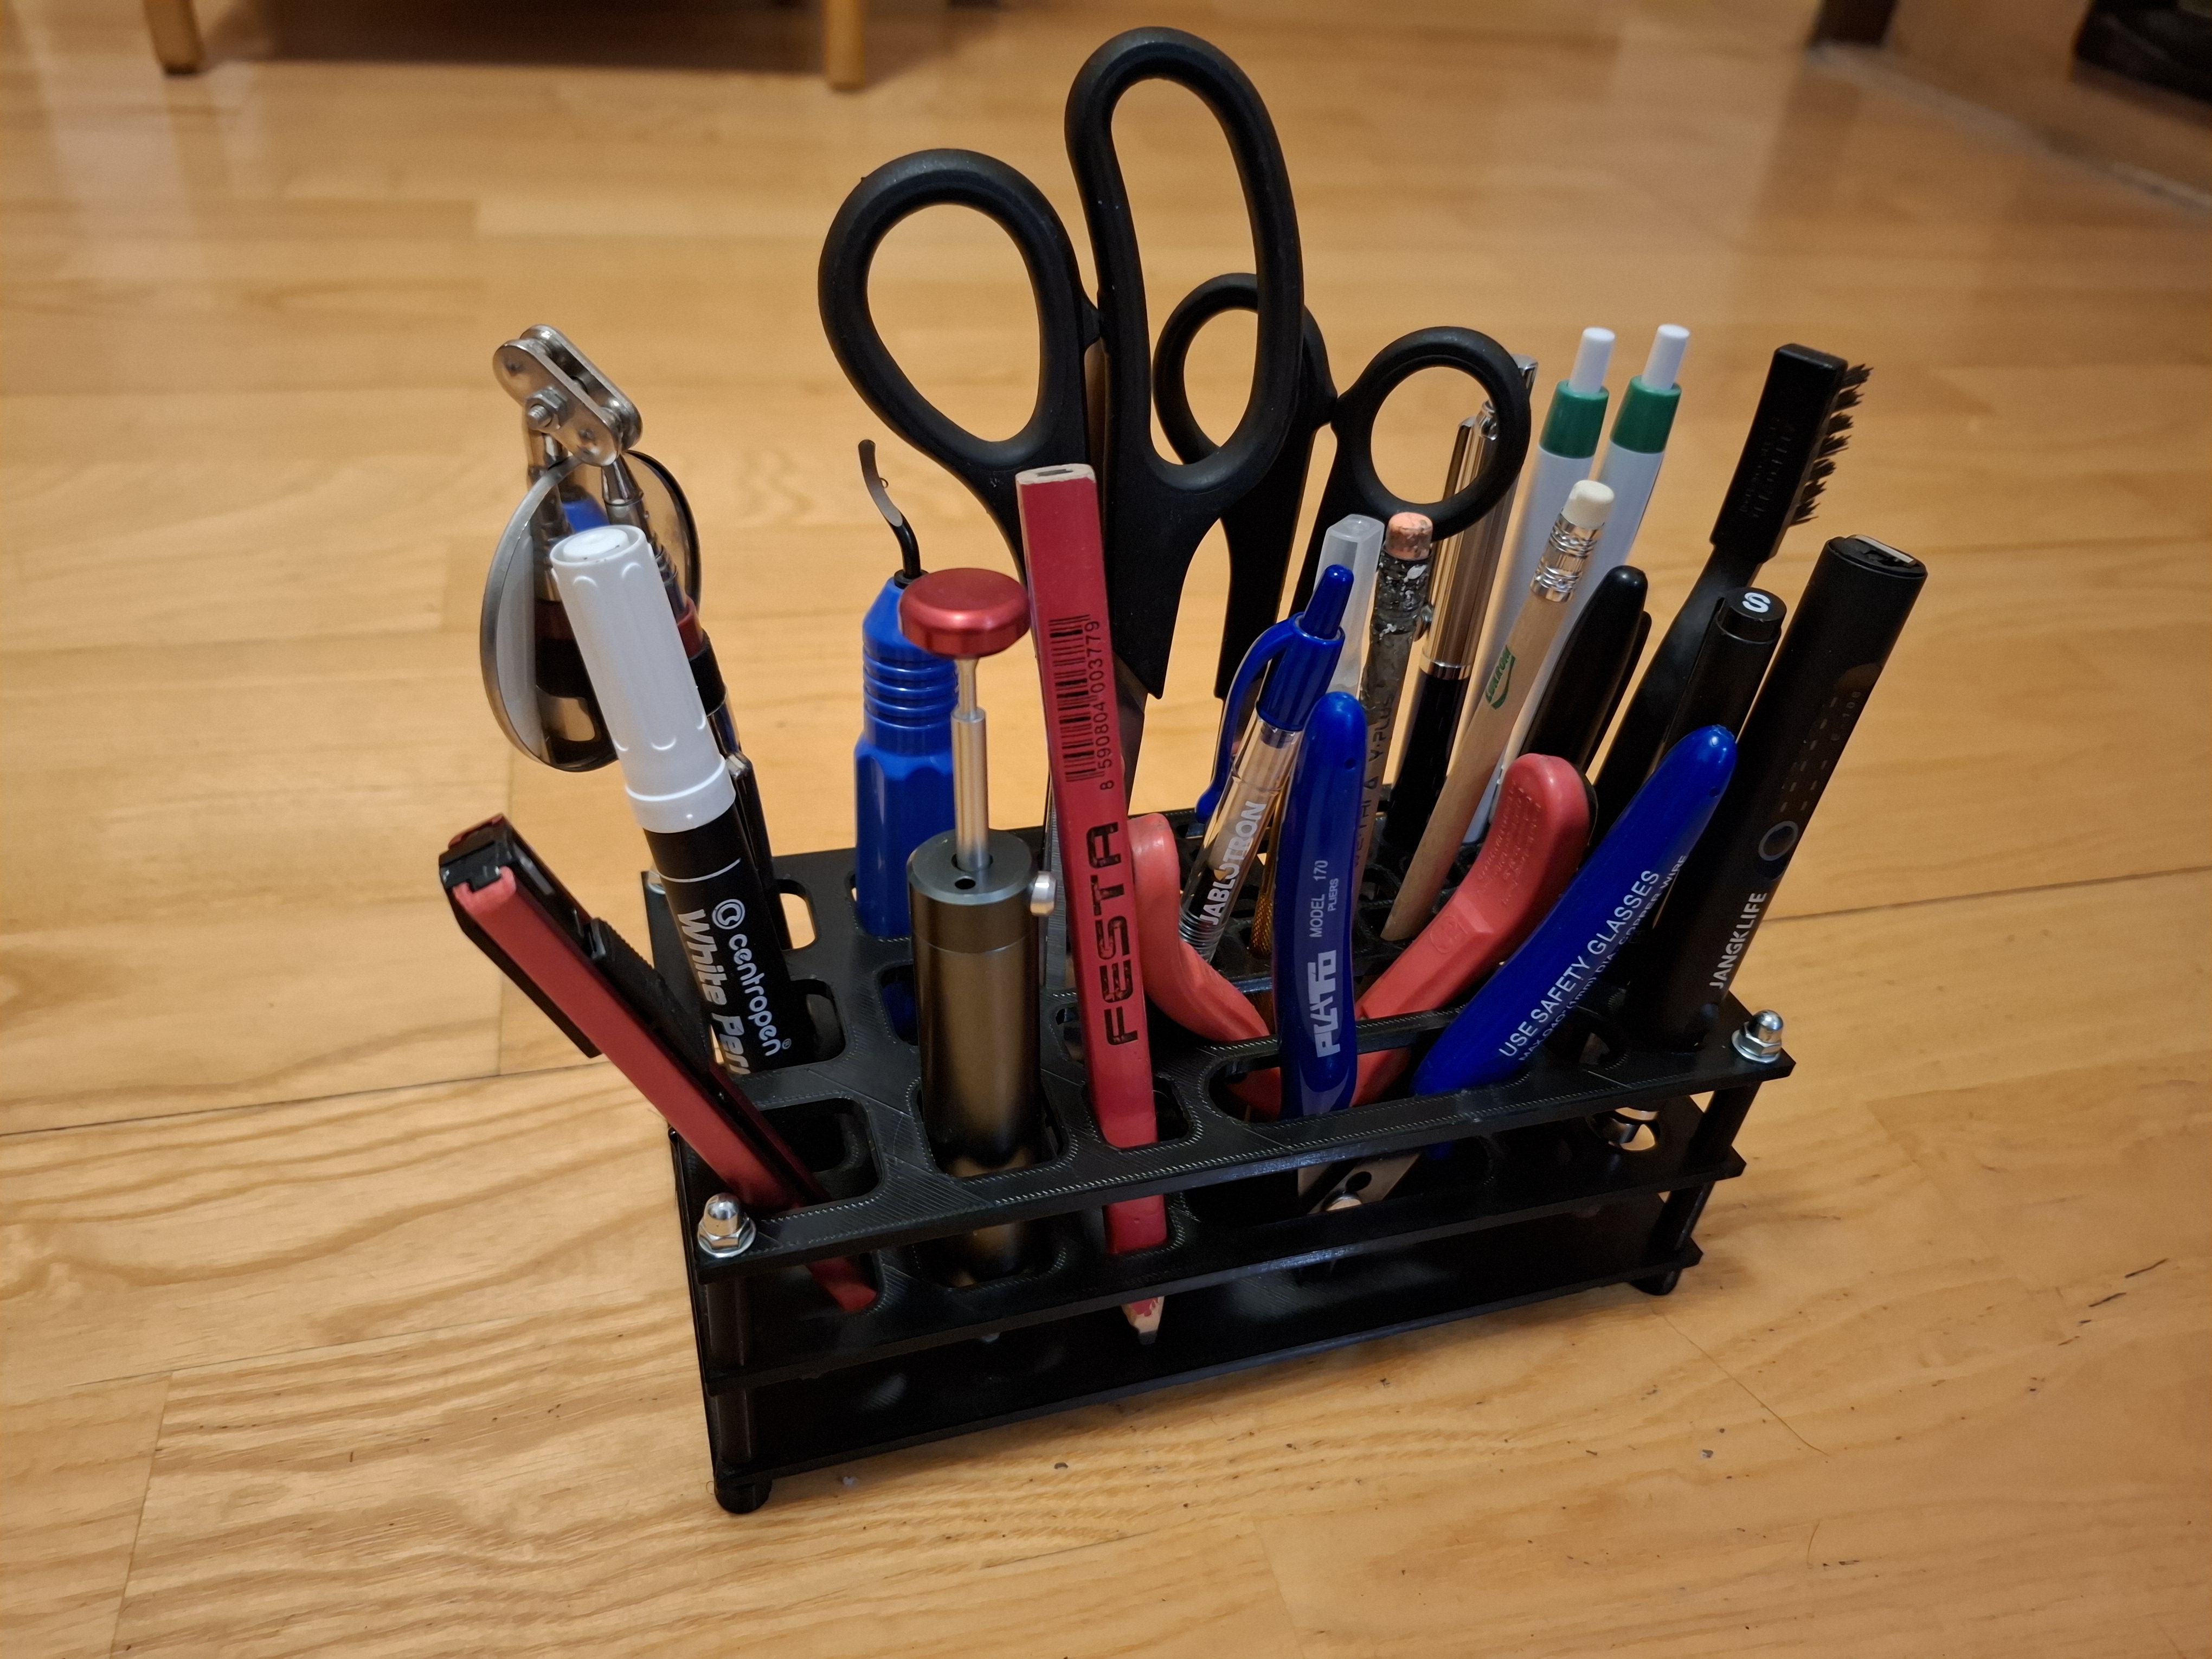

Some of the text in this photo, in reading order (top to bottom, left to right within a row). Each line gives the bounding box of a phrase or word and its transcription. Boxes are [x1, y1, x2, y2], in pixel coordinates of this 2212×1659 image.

[1742, 592, 1771, 613] S
[1084, 620, 1115, 790] 8 590804 003779
[1199, 800, 1267, 926] JABLOTRON
[1309, 860, 1329, 938] MODEL 170
[1327, 878, 1340, 912] PLIERS
[1659, 854, 1688, 890] WIRE
[677, 909, 728, 1006] White
[1086, 821, 1139, 1046] FESTA
[1498, 870, 1660, 1058] USE SAFETY GLASSES
[729, 934, 782, 1057] centropen
[1307, 949, 1341, 1058] PLATO
